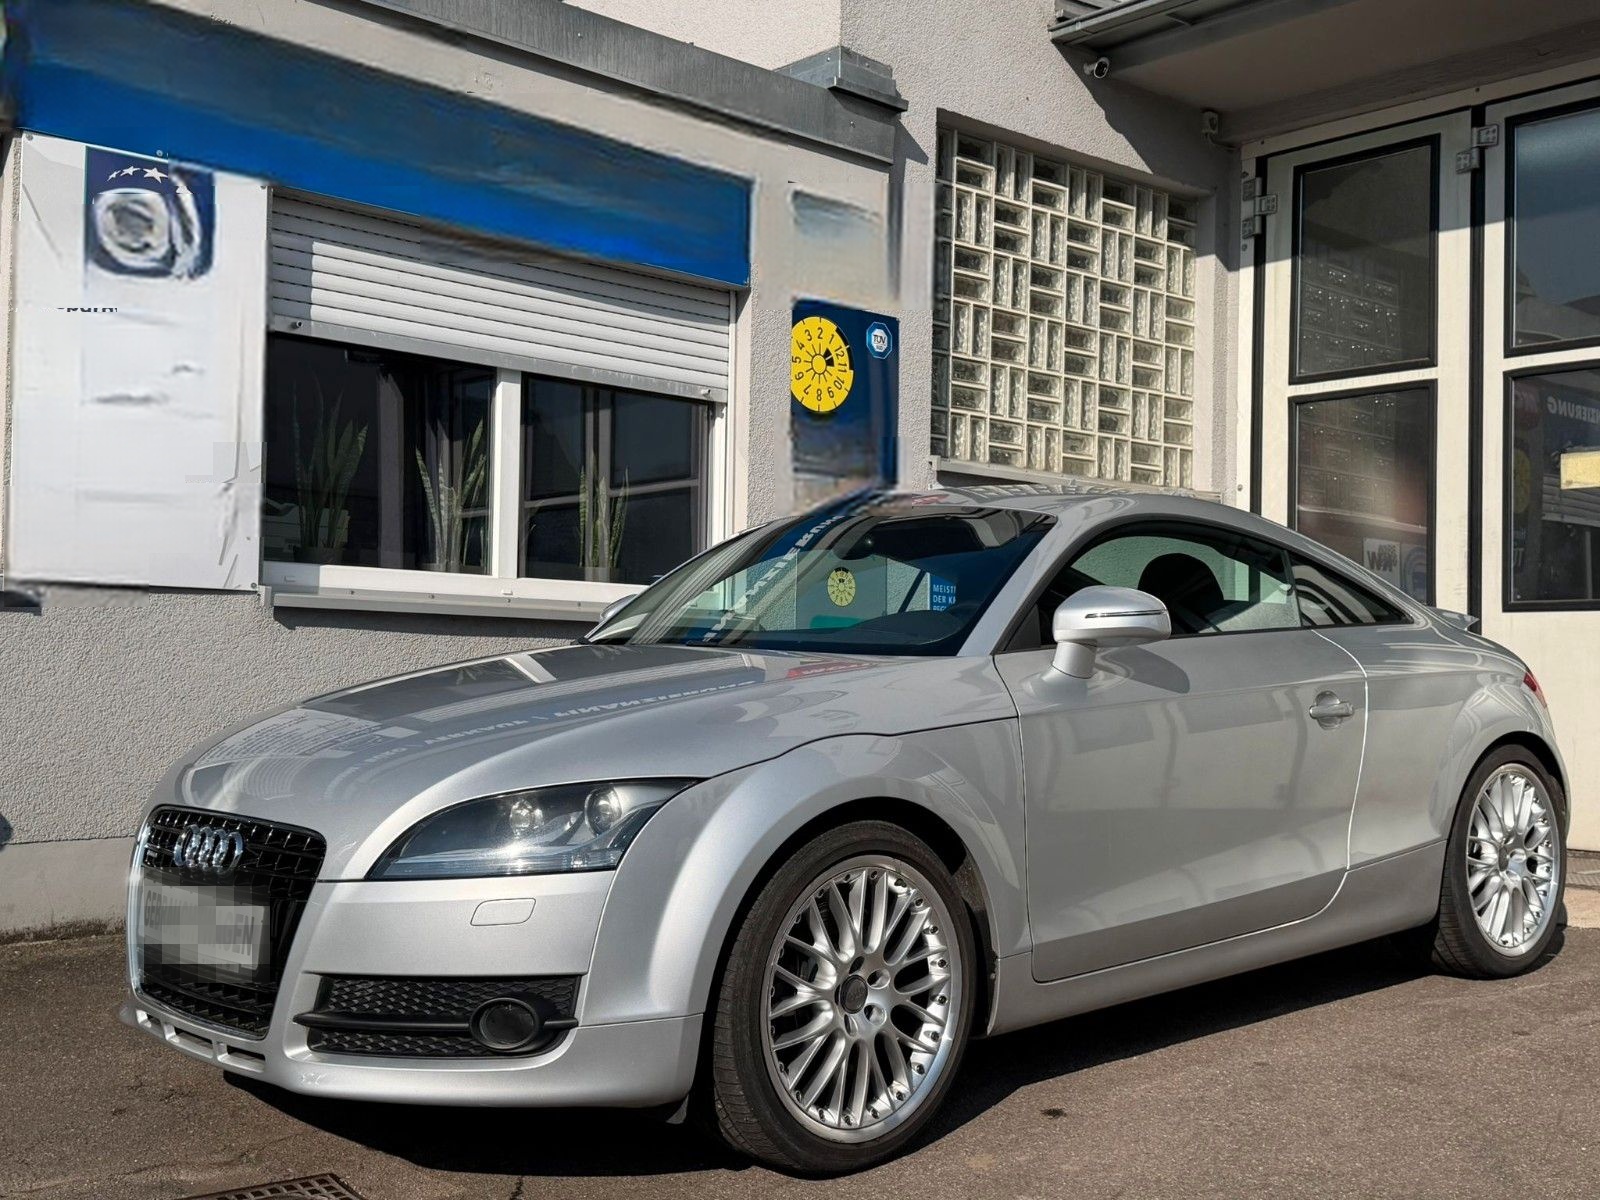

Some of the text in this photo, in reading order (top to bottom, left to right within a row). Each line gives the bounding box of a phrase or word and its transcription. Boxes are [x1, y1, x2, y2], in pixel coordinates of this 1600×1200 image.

[791, 327, 847, 401] 1 2 3 4 5 6 7 8 9 10 11 12
[933, 595, 946, 603] DER
